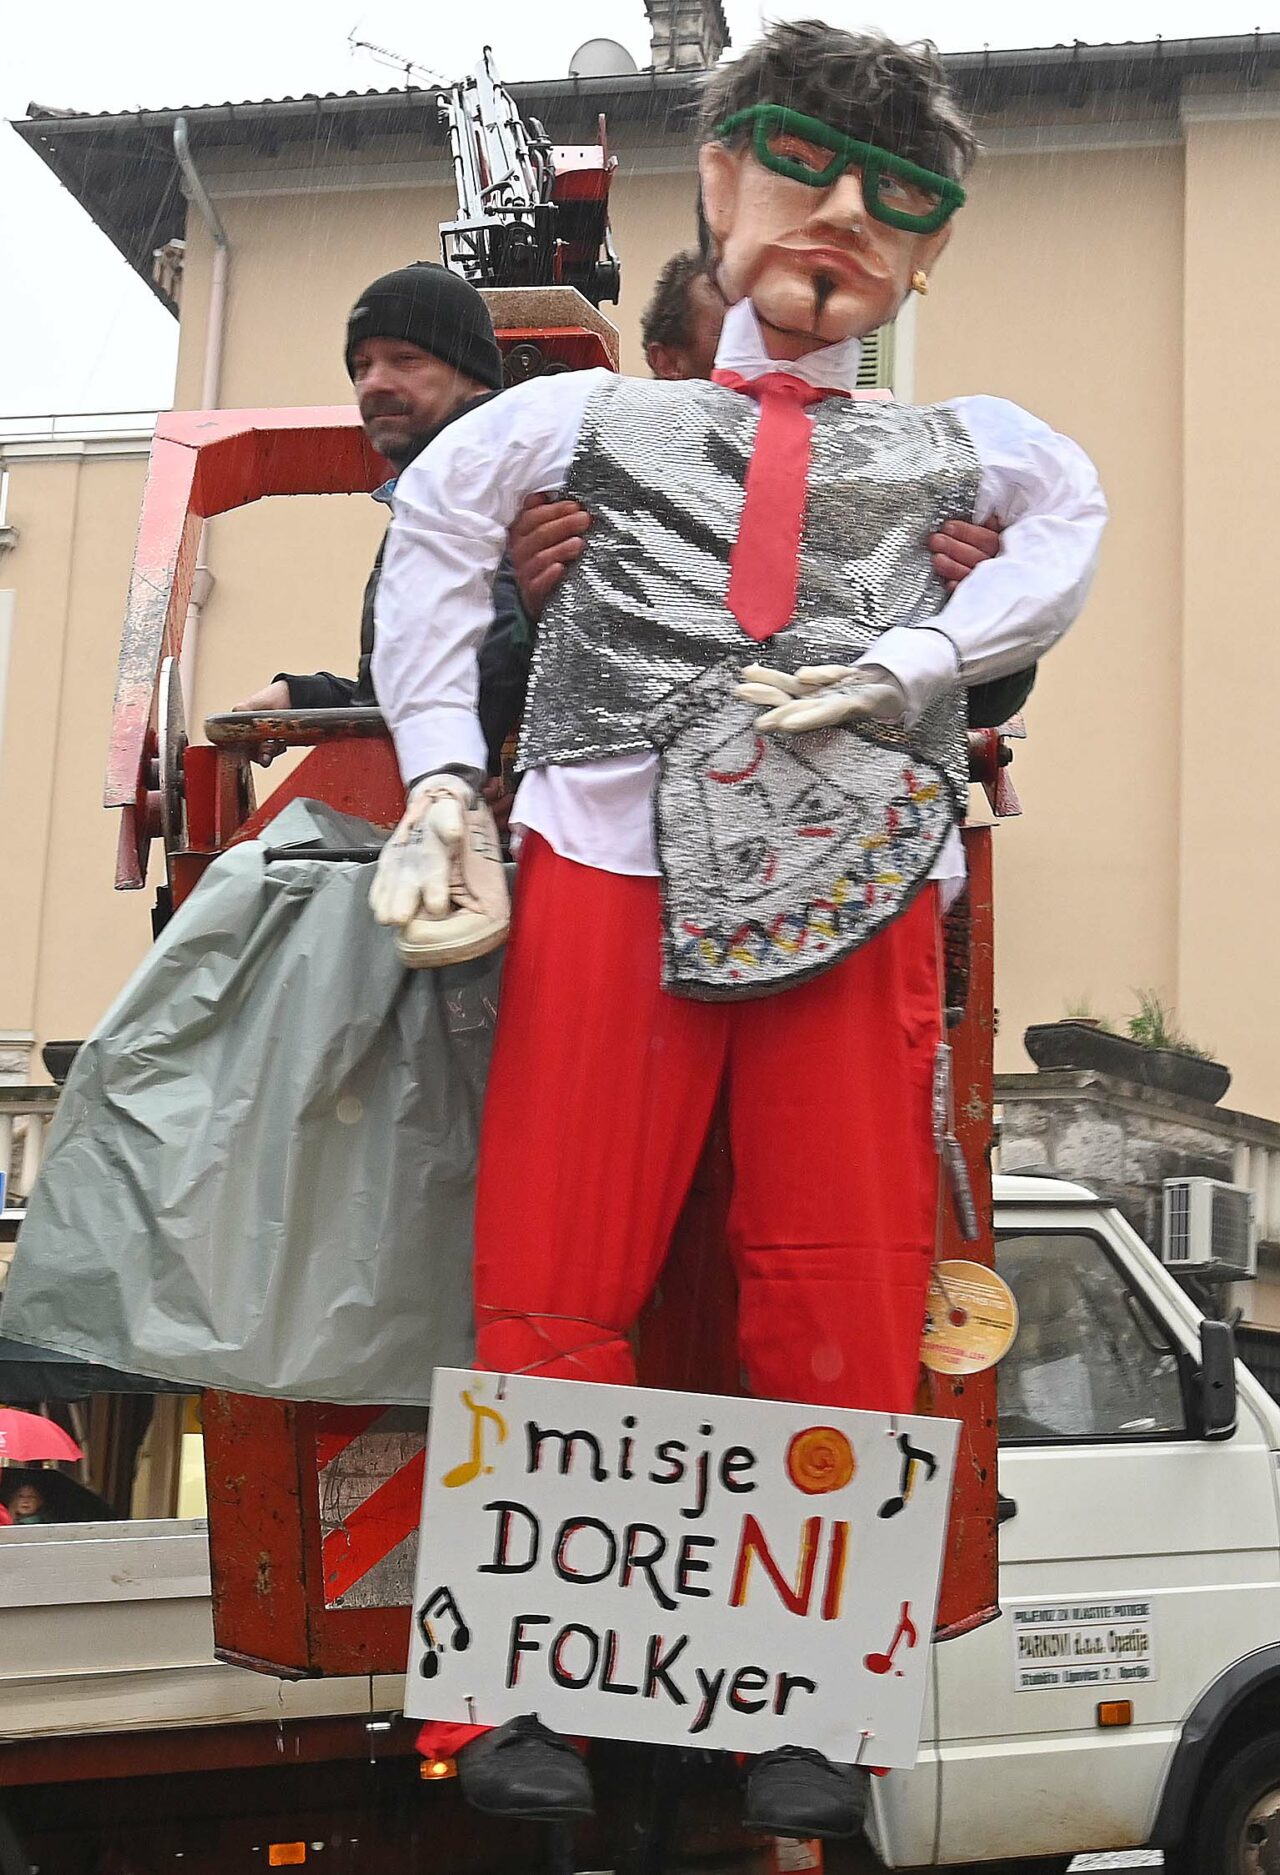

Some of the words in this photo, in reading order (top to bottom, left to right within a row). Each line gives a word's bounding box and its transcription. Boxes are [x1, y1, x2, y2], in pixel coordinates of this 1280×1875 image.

[524, 1414, 757, 1519] misje
[504, 1613, 818, 1735] FOLKyer
[1074, 1631, 1107, 1655] d.o.o.
[1107, 1628, 1150, 1658] Opatija
